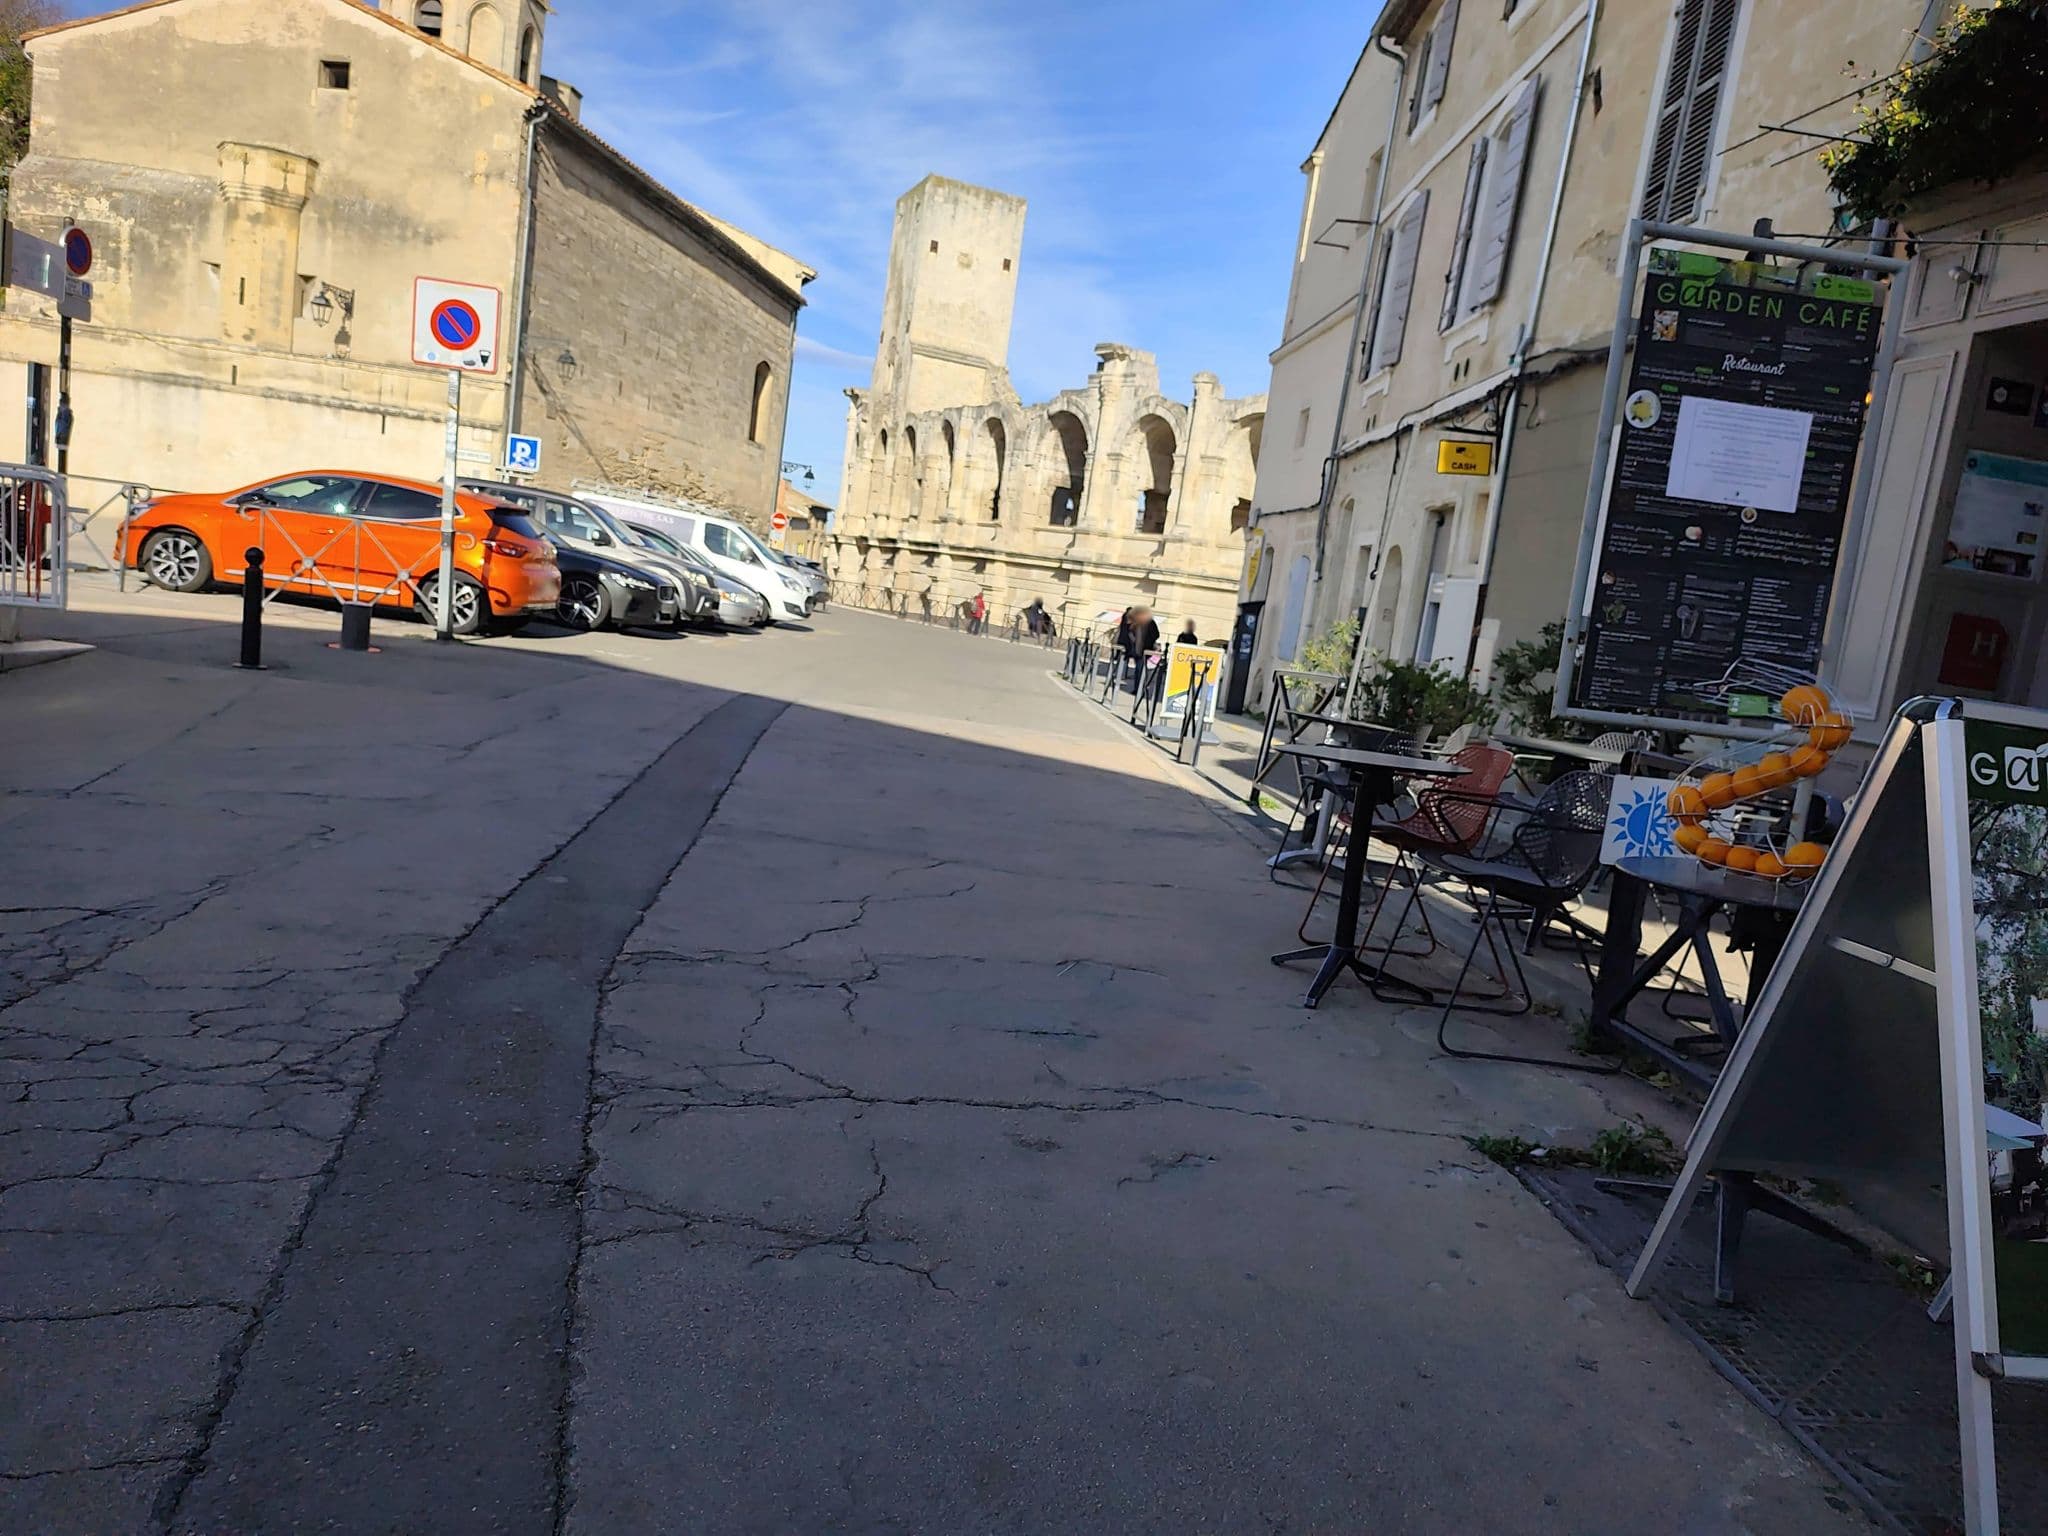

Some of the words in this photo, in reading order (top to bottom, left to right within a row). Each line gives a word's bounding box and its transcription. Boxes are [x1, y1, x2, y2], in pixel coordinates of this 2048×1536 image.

[1800, 303, 1870, 331] CAFÉ
[1721, 354, 1786, 375] Restaurant
[1451, 462, 1477, 471] CASH
